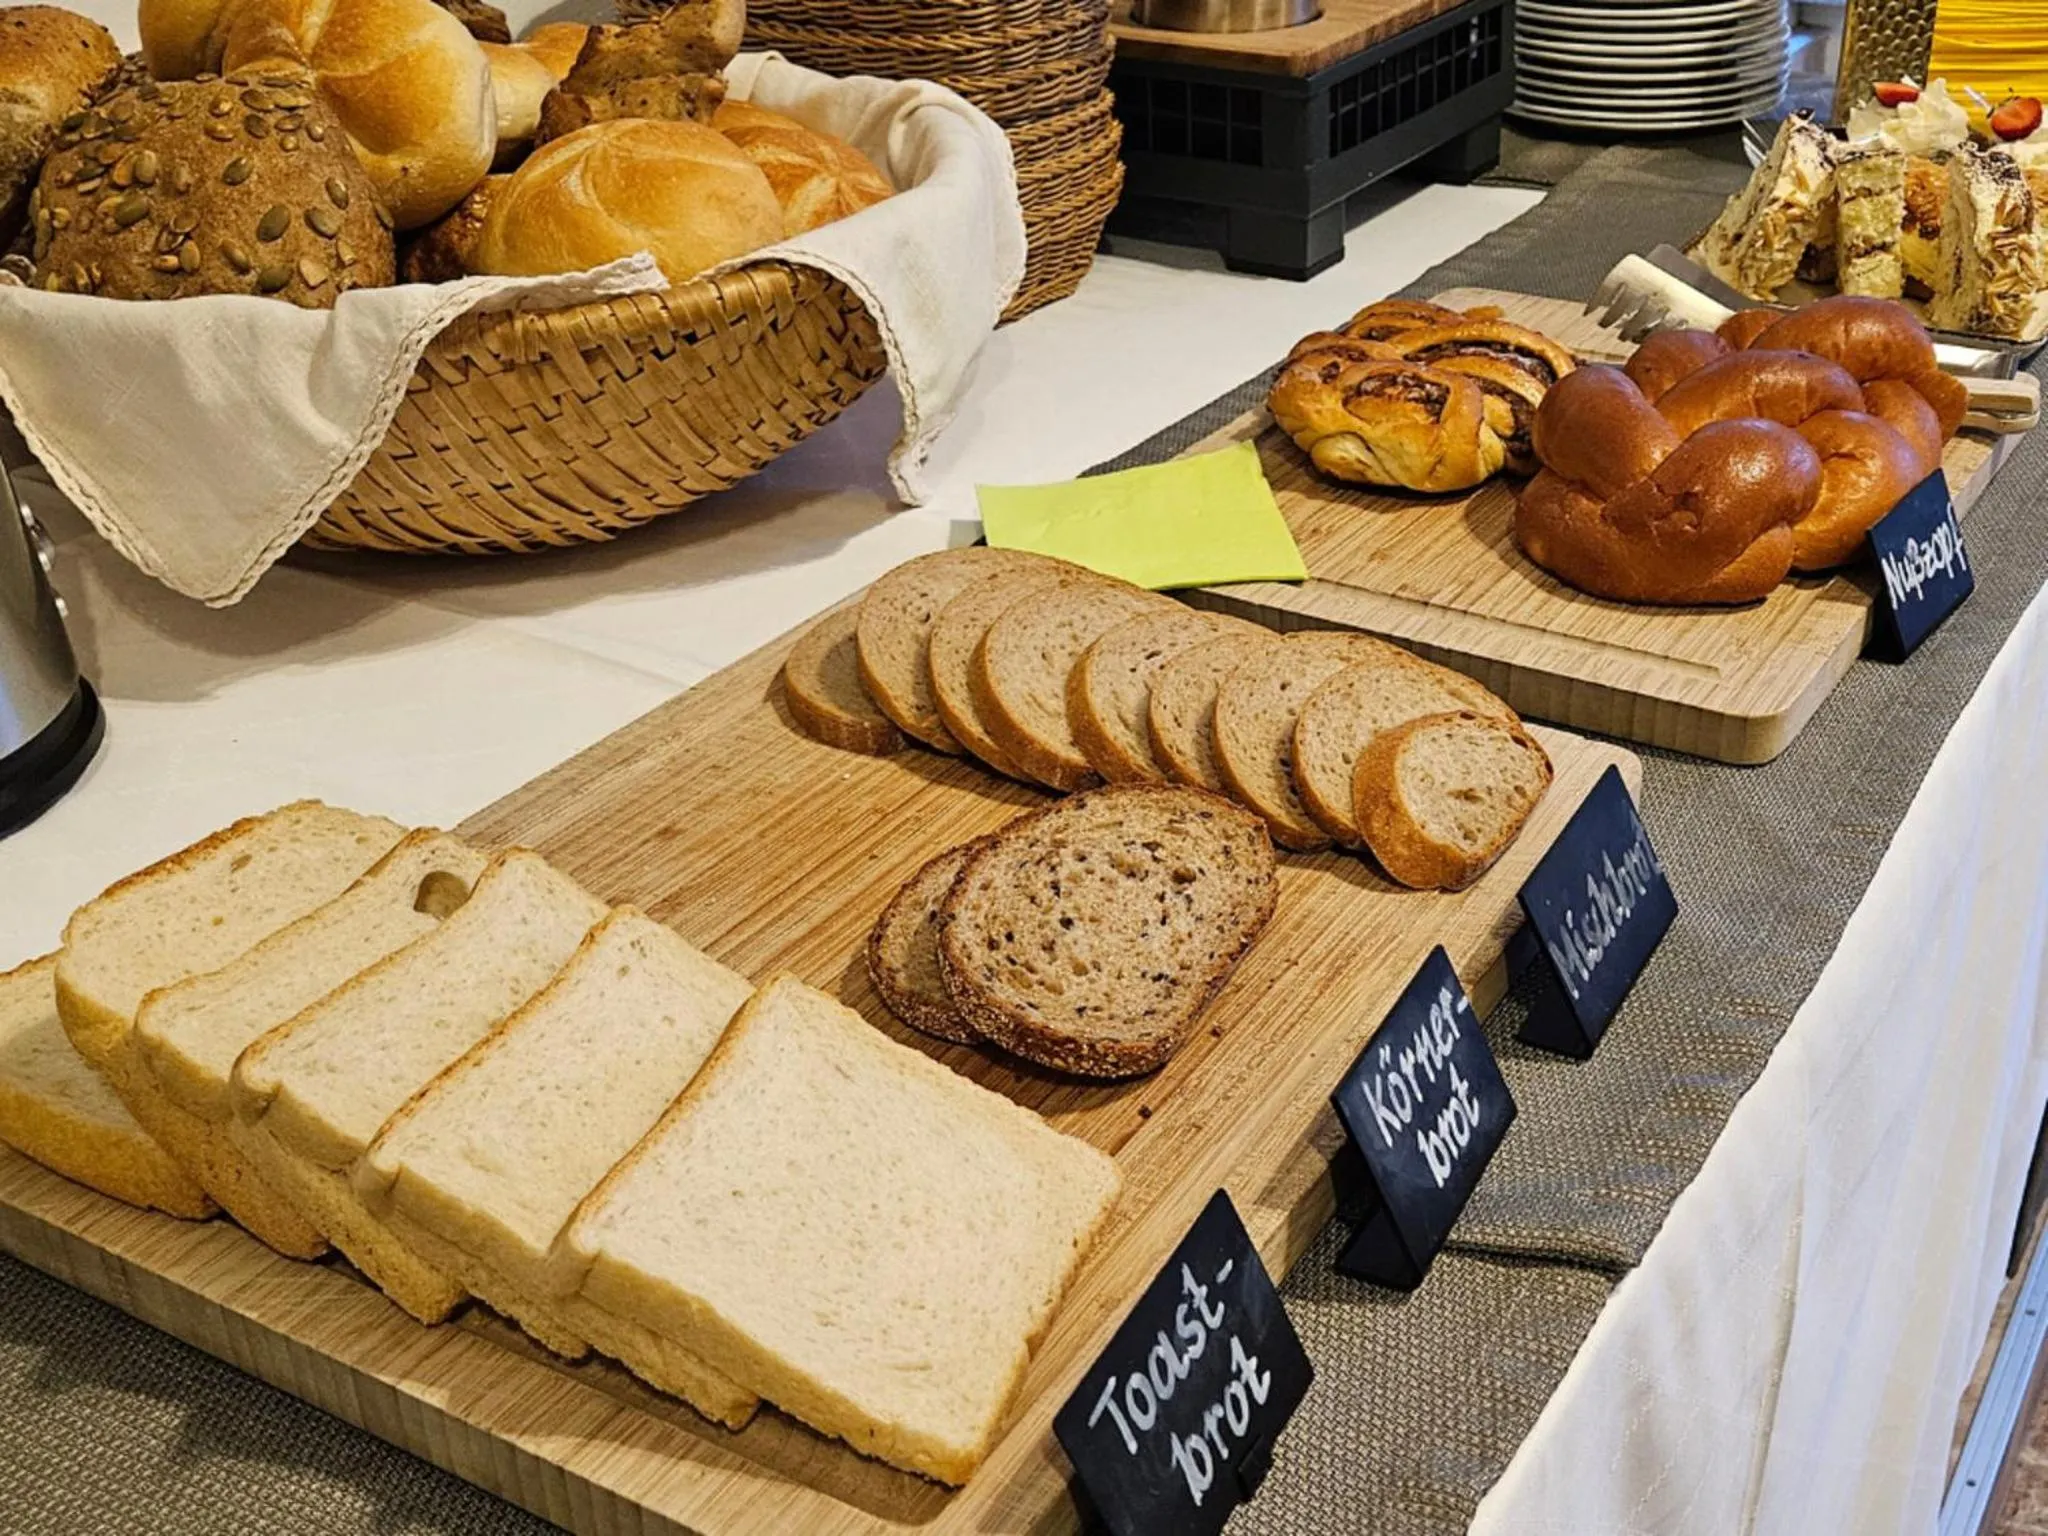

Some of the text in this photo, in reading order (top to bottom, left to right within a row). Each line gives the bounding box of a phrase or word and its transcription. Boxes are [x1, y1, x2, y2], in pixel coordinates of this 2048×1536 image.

[1361, 985, 1469, 1149] Körner-
[1416, 1062, 1481, 1189] brot
[1087, 1258, 1234, 1456] Toast-
[1170, 1334, 1271, 1507] brot
